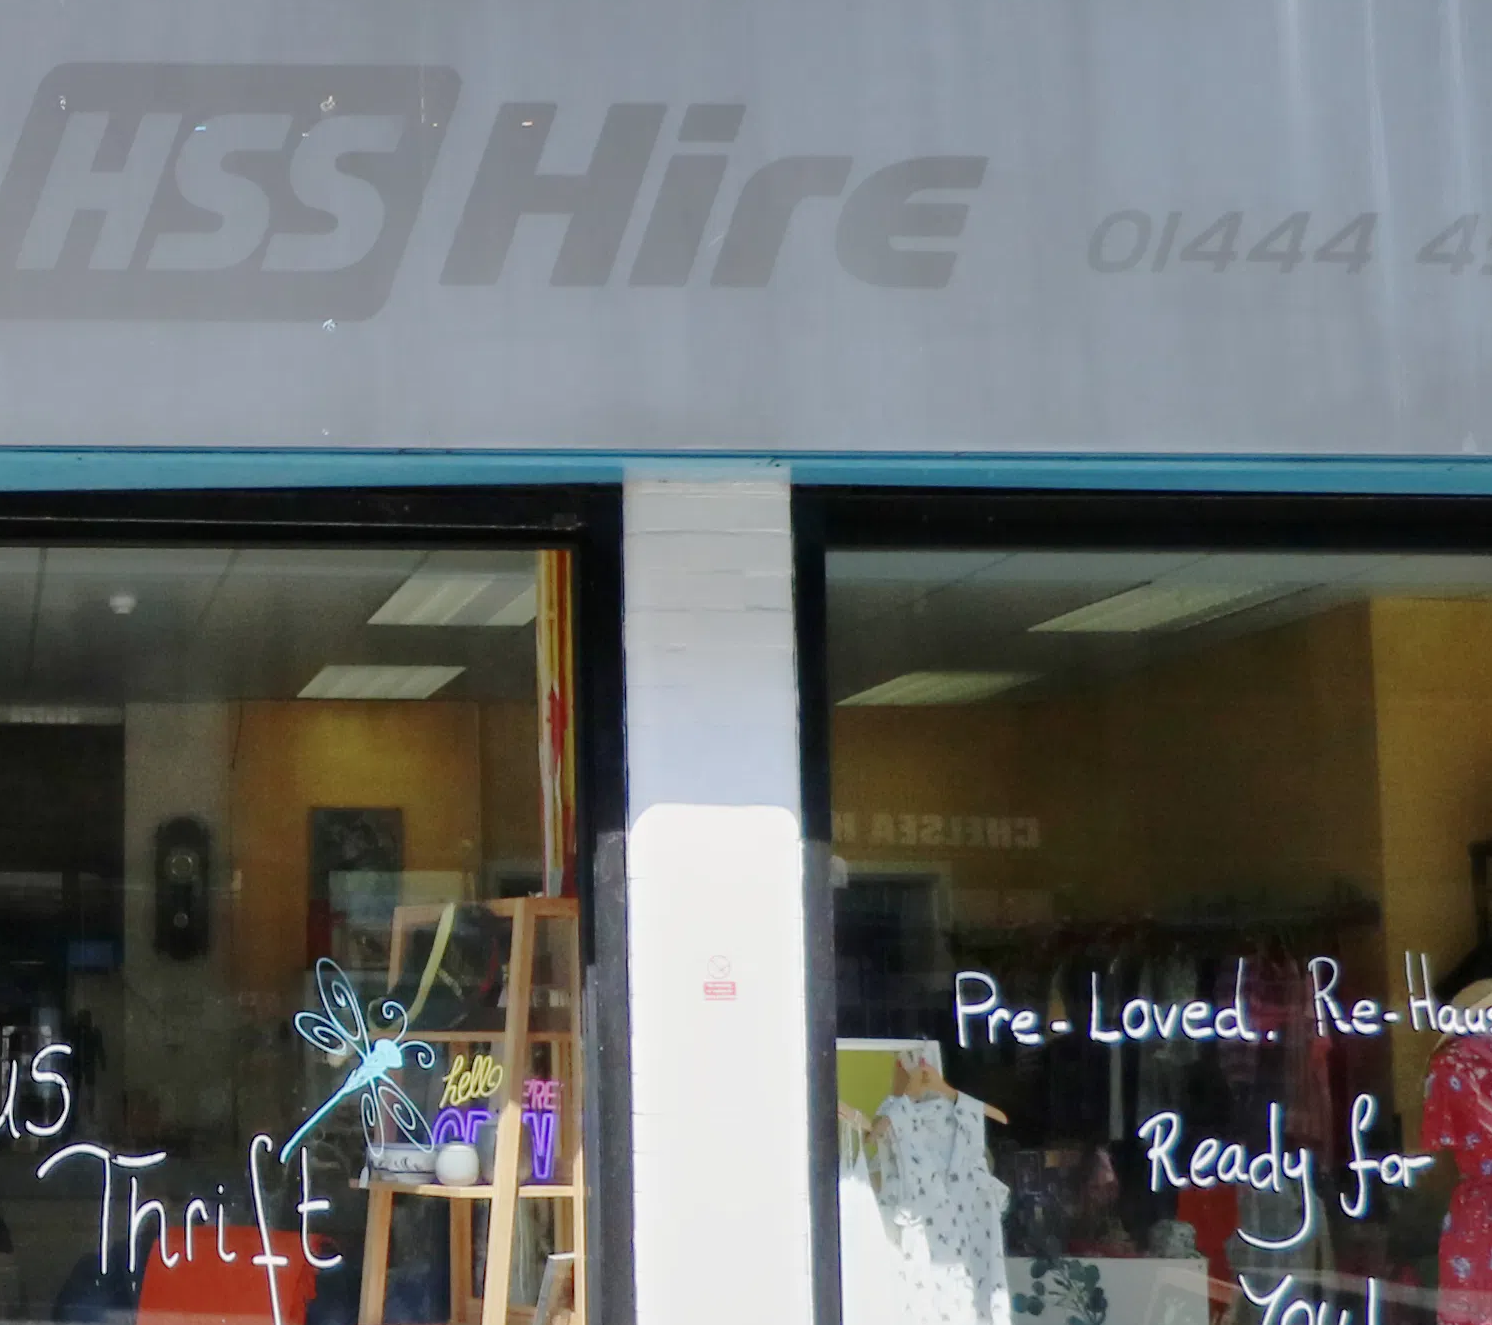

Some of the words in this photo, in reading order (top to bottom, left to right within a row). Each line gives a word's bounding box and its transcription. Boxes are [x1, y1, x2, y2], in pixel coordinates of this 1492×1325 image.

[11, 110, 412, 275] HSS
[438, 100, 990, 290] Hire
[1085, 208, 1379, 276] 01444
[438, 1054, 504, 1109] hello
[432, 1106, 556, 1181] OPN
[1138, 1100, 1322, 1251] Ready
[1339, 1092, 1435, 1219] for
